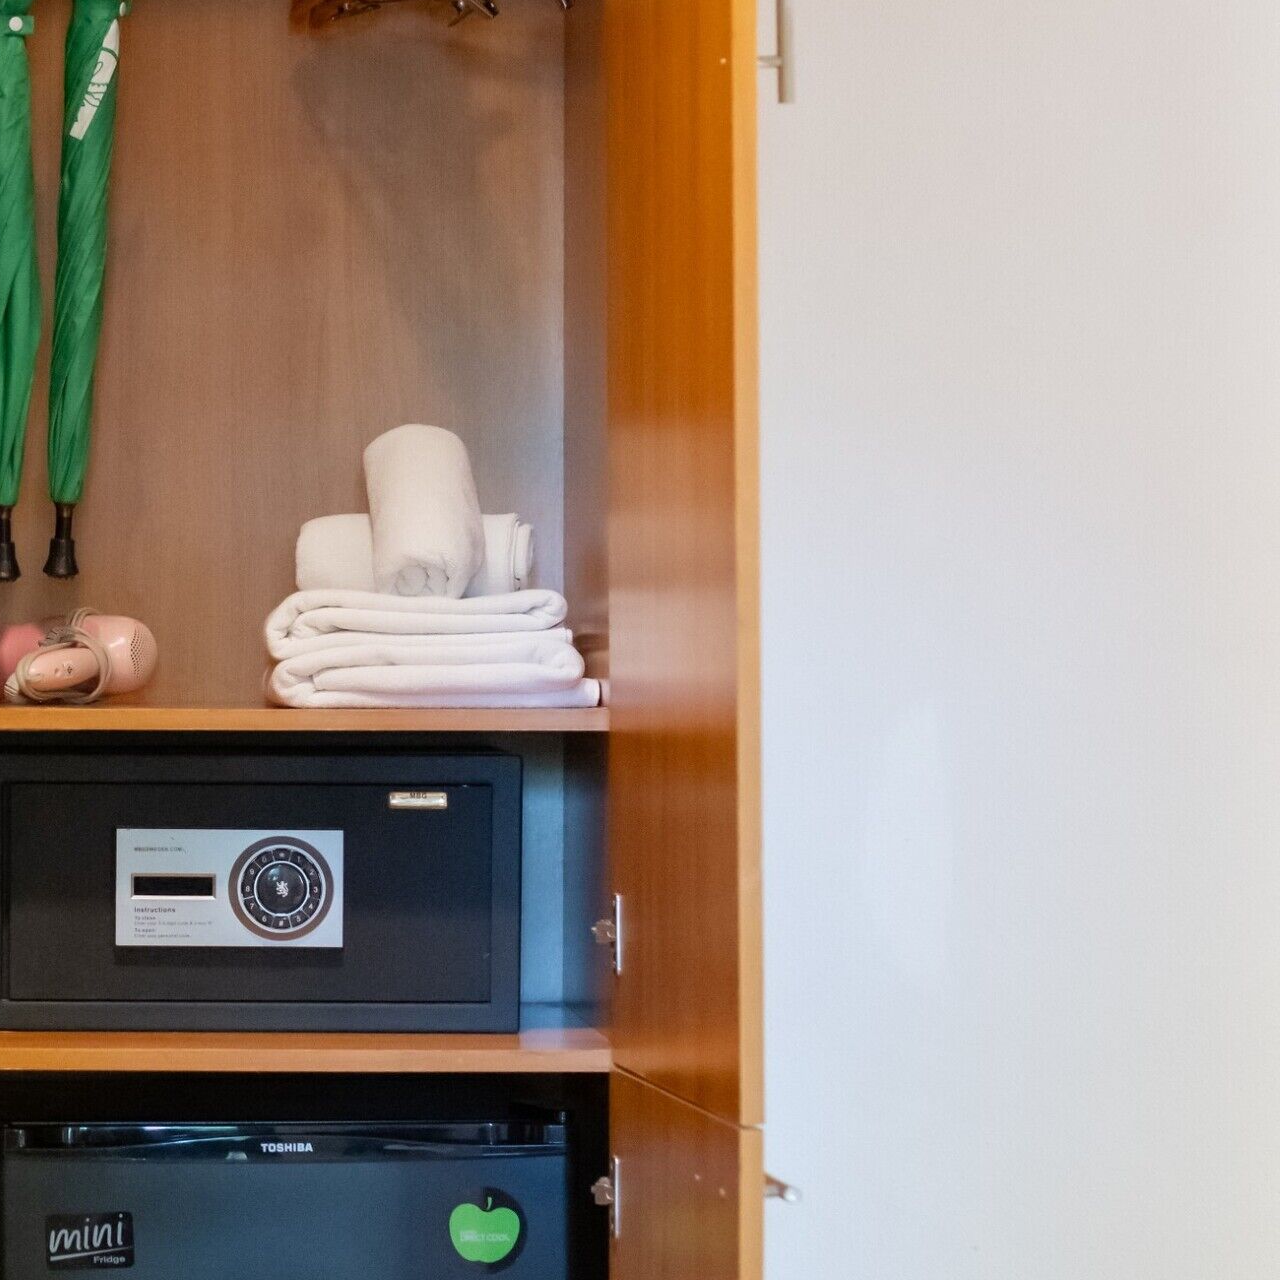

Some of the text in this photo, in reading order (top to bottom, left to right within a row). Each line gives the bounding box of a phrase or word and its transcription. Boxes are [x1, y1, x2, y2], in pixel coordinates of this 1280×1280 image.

[260, 1142, 314, 1153] TOSHIBA
[49, 1213, 124, 1253] mini
[93, 1255, 126, 1264] Fridge
